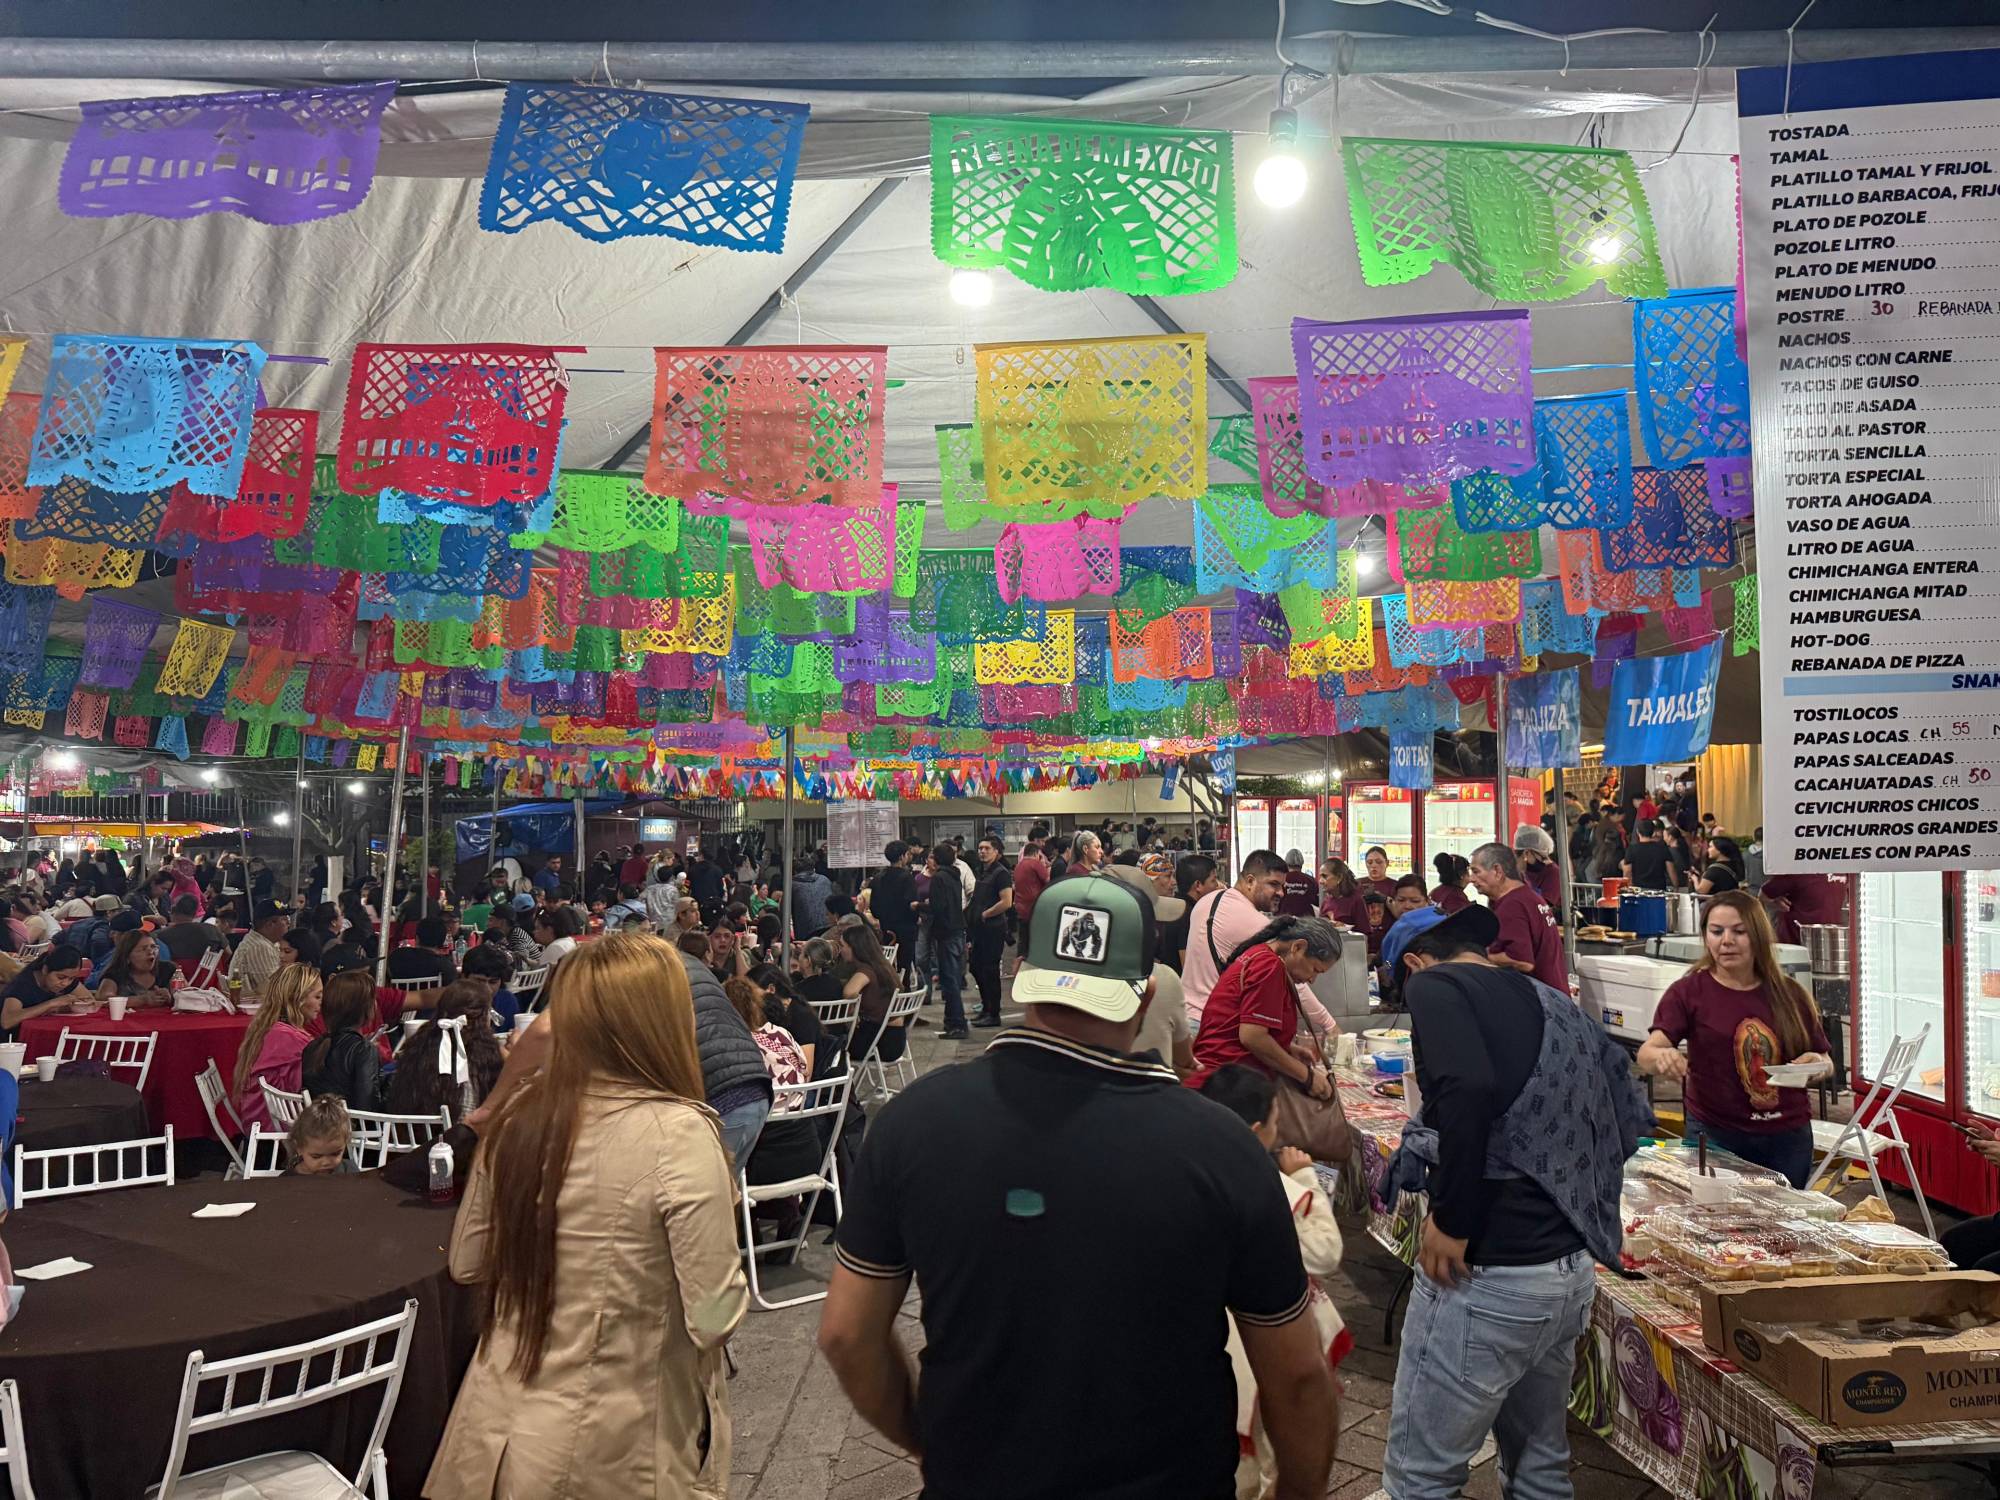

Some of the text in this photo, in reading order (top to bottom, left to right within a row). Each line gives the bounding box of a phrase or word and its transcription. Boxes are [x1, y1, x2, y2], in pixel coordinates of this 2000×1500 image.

[1769, 124, 1849, 142] TOSTADA
[1098, 136, 1216, 193] MEXICO
[1770, 149, 1829, 164] TAMAL
[1771, 161, 1992, 187] PLATILLO TAMAL Y FRIJOL
[1772, 193, 1854, 210] PLATILLO
[1857, 187, 1957, 204] BARBACOA,
[1773, 211, 1927, 233] PLATO DE POZOLE
[1774, 236, 1895, 256] POZOLE LITRO
[1775, 257, 1936, 279] PLATO DE MENUDO
[1776, 282, 1905, 302] MENUDO LITRO
[1777, 309, 1845, 325] POSTRE
[1871, 300, 1992, 316] 30 REBANADA
[1778, 331, 1850, 348] NACHOS
[1779, 350, 1952, 371] NACHOS CON CARNE
[1781, 375, 1919, 394] TACOS DE GUISO
[1782, 398, 1917, 417] TACO DE ASADA
[1783, 421, 1926, 441] TACO AL PASTOR
[1784, 445, 1926, 464] TORTA SENCILLA
[1785, 468, 1926, 487] TORTA ESPECIAL
[1785, 491, 1932, 510] TORTA AHOGADA
[1787, 516, 1910, 533] VASO DE AGUA
[1787, 539, 1915, 556] LITRO DE AGUA
[1788, 560, 1979, 580] CHIMICHANGA ENTERA
[1789, 584, 1967, 602] CHIMICHANGA MITAD
[1789, 608, 1922, 625] HAMBURGUESA
[1790, 633, 1870, 648] HOT-DOG
[1791, 654, 1965, 671] REBANADA DE PIZZA
[1627, 685, 1712, 727] TAMALES
[1793, 706, 1899, 722] TOSTILOCOS
[1793, 730, 1909, 745] PAPAS LOCAS
[1920, 721, 1970, 739] CH 55
[1393, 744, 1429, 767] TORTAS
[1793, 751, 1954, 769] PAPAS SALCEADAS
[1794, 775, 1934, 791] CACAHUATADAS
[1942, 767, 1991, 785] CH 50
[1794, 798, 1979, 815] CEVICHURROS CHICOS
[644, 825, 674, 834] BANCO
[1794, 820, 1998, 838] CEVICHURROS GRANDES
[1794, 844, 1971, 861] BONELES CON PAPAS
[1846, 1385, 1902, 1400] MONTE REY
